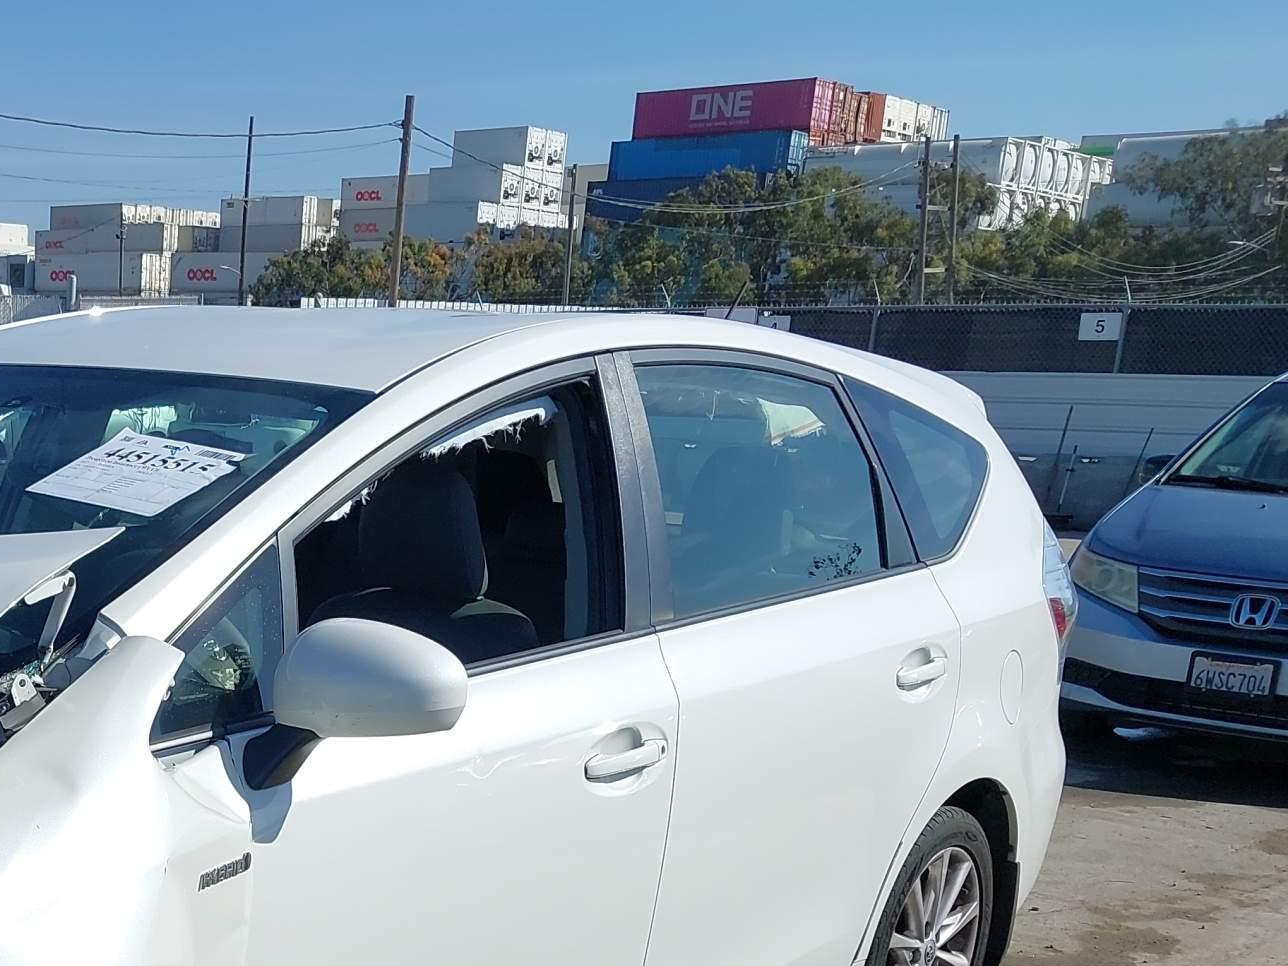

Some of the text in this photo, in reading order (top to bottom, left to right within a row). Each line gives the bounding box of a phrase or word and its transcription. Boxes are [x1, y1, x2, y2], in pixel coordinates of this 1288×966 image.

[690, 90, 754, 120] ONE
[355, 190, 382, 201] OOCL
[353, 223, 379, 233] OOCL
[187, 268, 217, 281] OOCL
[1094, 319, 1106, 334] 5
[103, 447, 217, 474] 44515515
[1193, 668, 1267, 694] 6WSC704
